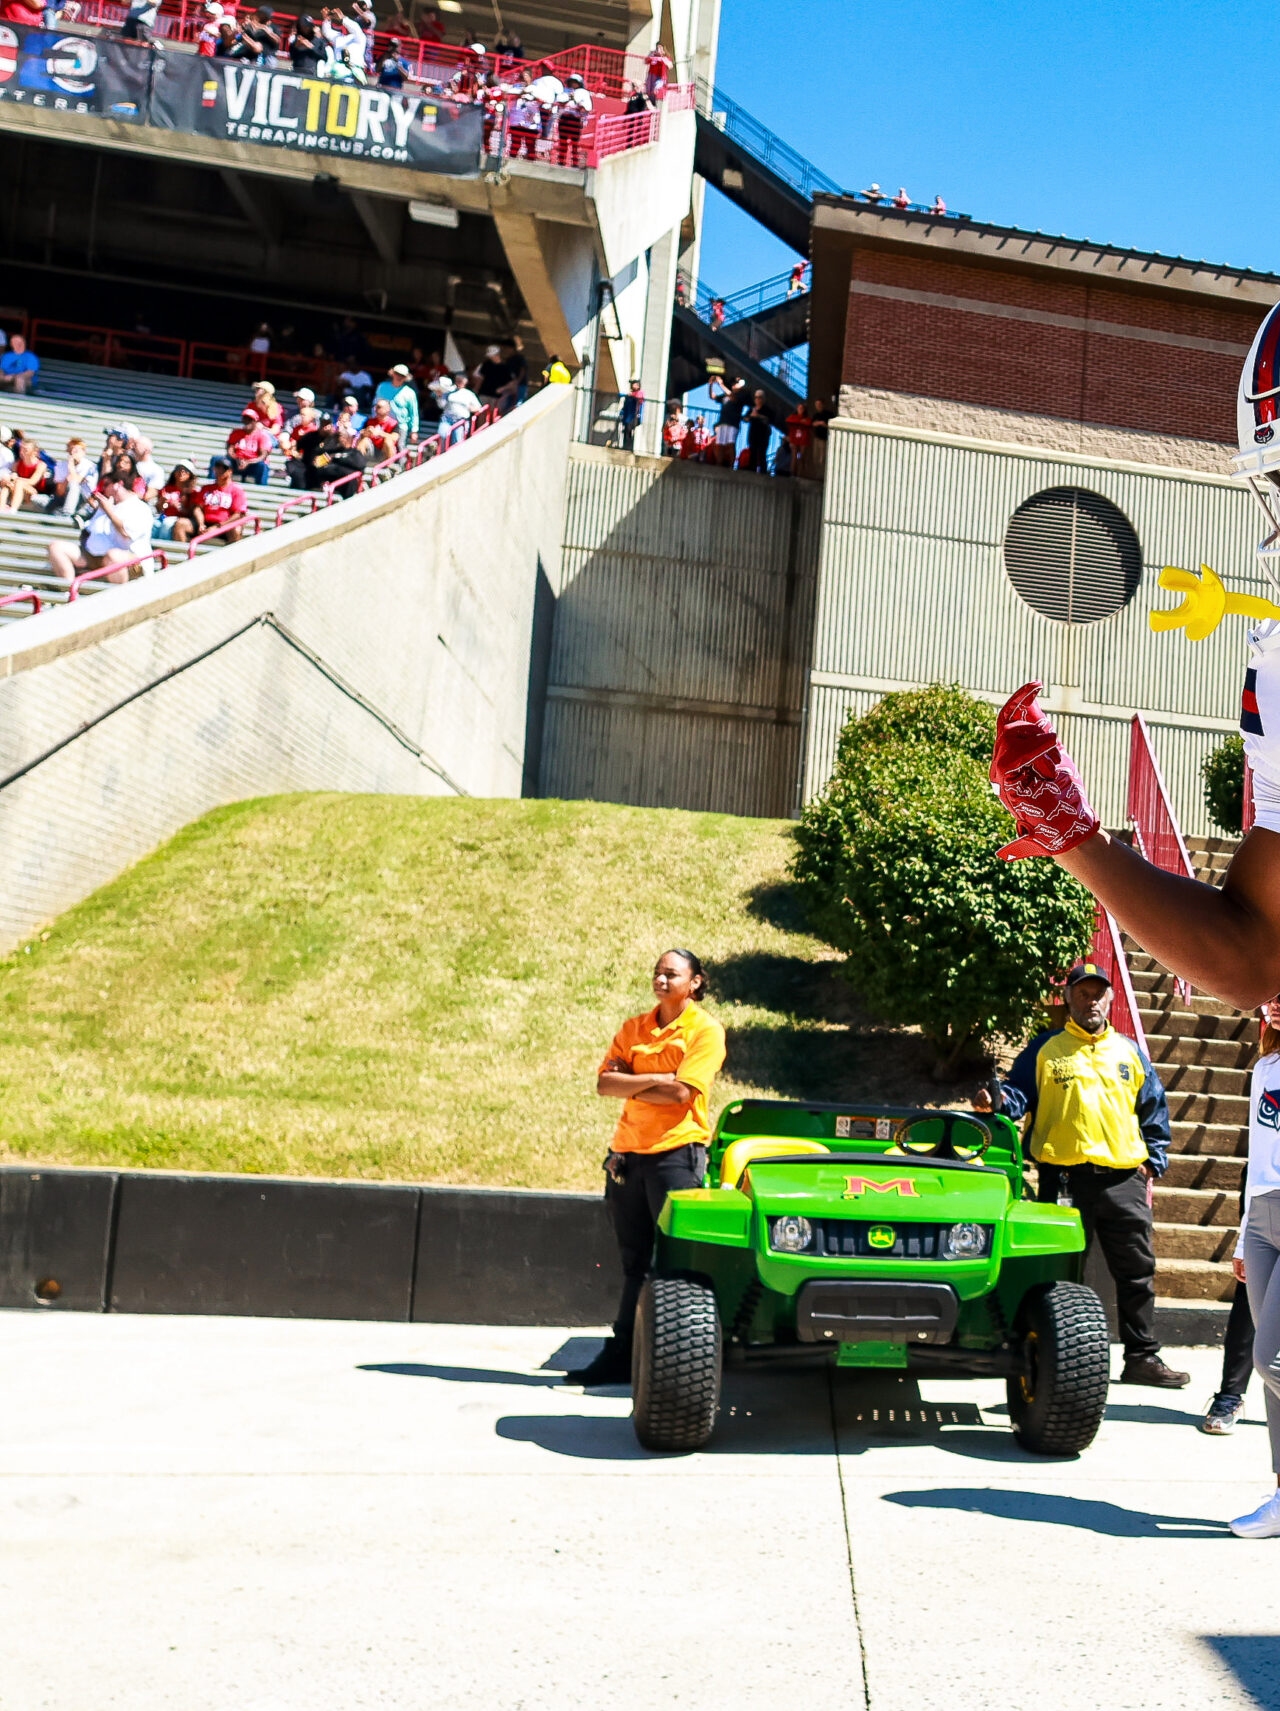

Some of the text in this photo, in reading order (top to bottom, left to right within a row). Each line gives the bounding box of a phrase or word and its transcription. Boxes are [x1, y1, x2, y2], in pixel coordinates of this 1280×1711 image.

[223, 65, 421, 147] VICTORY
[225, 121, 409, 162] TERRAPINCLUB.COM
[842, 1175, 921, 1198] M
